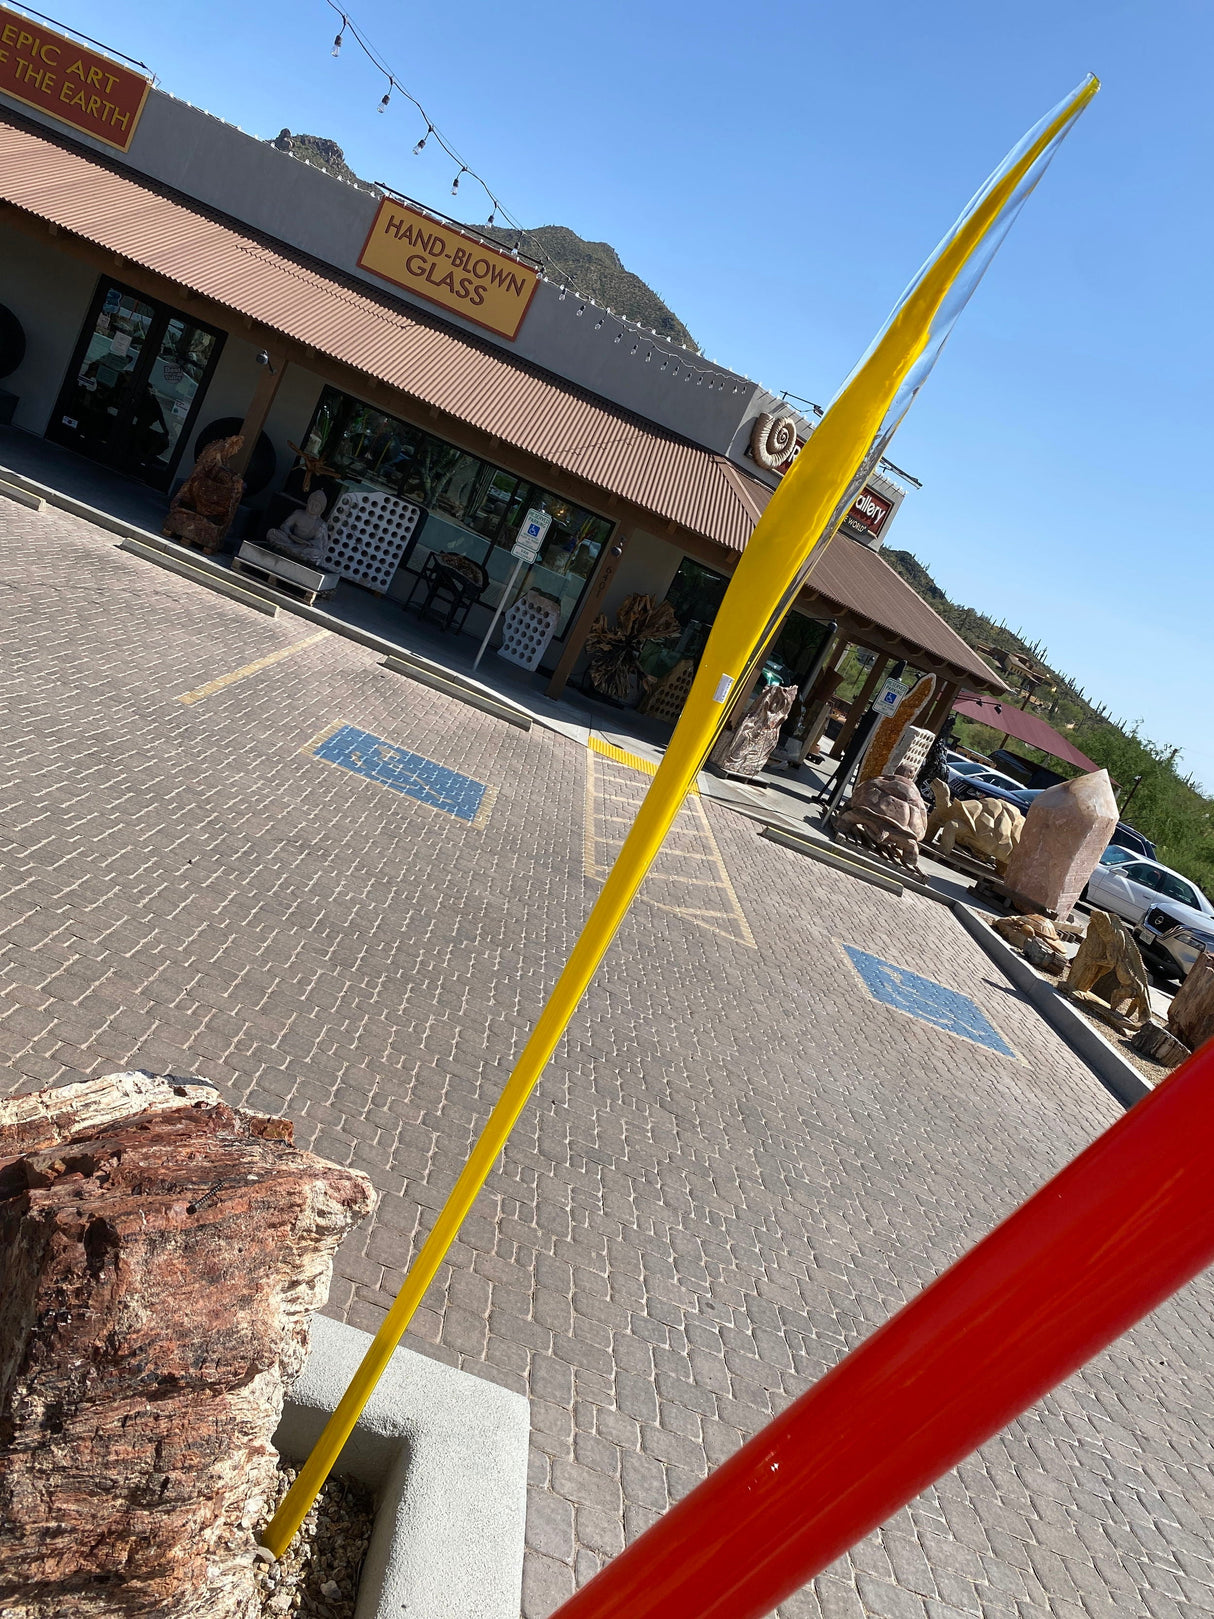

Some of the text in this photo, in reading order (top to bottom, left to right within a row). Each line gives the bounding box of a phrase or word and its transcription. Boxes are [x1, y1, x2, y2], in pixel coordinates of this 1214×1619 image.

[1, 23, 120, 94] EPIC ART
[15, 57, 57, 95] THE
[59, 81, 131, 131] EARTH
[384, 214, 527, 297] HAND-BLOWN
[405, 254, 488, 306] GLASS
[855, 494, 886, 524] allery
